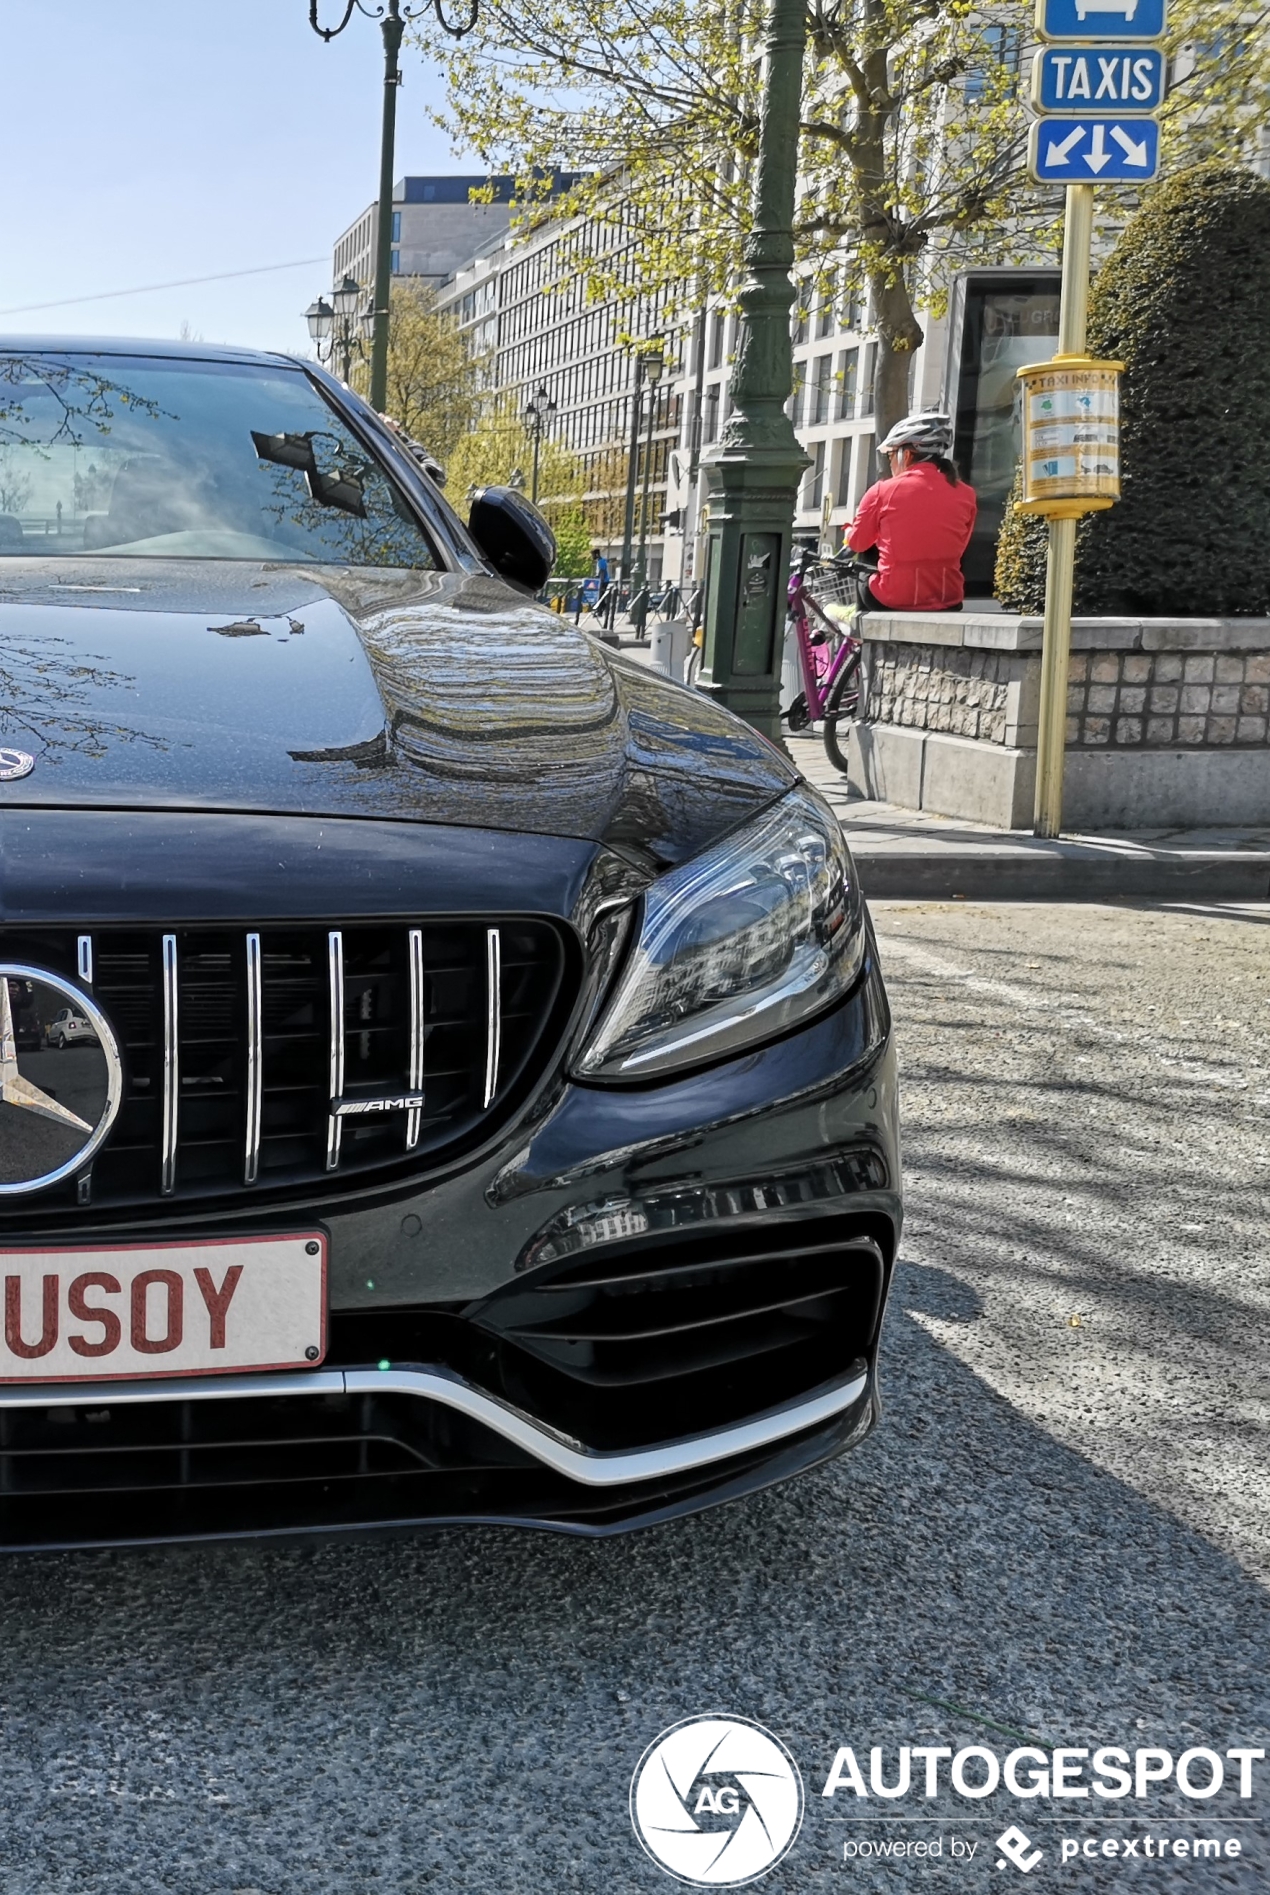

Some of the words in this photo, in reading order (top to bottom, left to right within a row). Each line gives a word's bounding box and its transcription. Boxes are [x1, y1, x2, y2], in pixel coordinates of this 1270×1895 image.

[1051, 57, 1153, 100] TAXIS
[1039, 375, 1069, 388] TAXI
[1072, 373, 1099, 385] INFO
[364, 1097, 423, 1112] AMG
